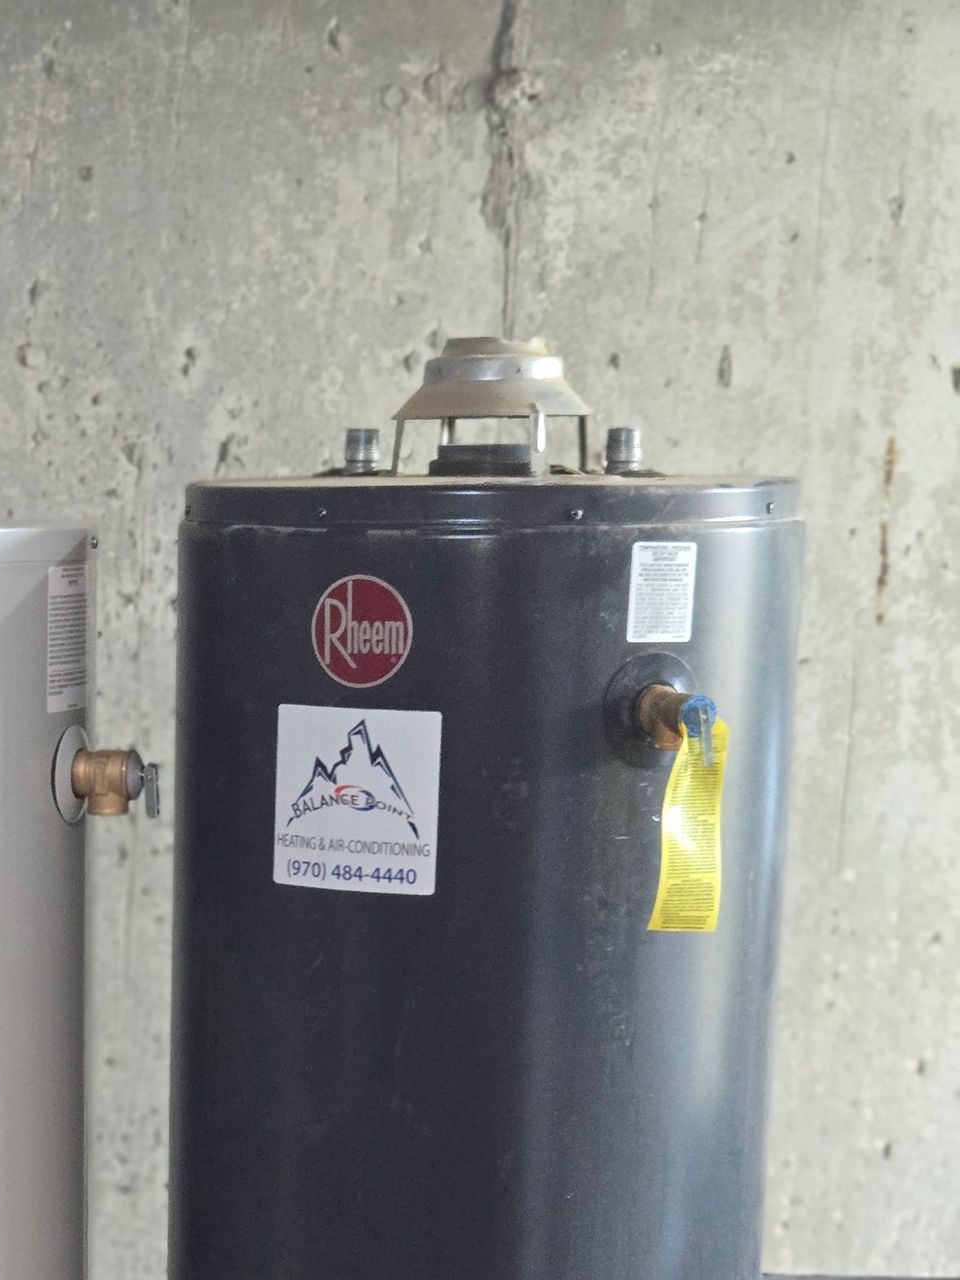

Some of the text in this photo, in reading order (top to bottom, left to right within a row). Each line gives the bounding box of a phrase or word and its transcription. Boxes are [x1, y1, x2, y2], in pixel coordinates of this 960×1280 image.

[324, 579, 404, 669] Rheem
[292, 794, 413, 820] BALANCE POINT
[277, 834, 430, 858] HEATING & AIR-CONDITIONING
[286, 860, 416, 885] (970) 484-4440
